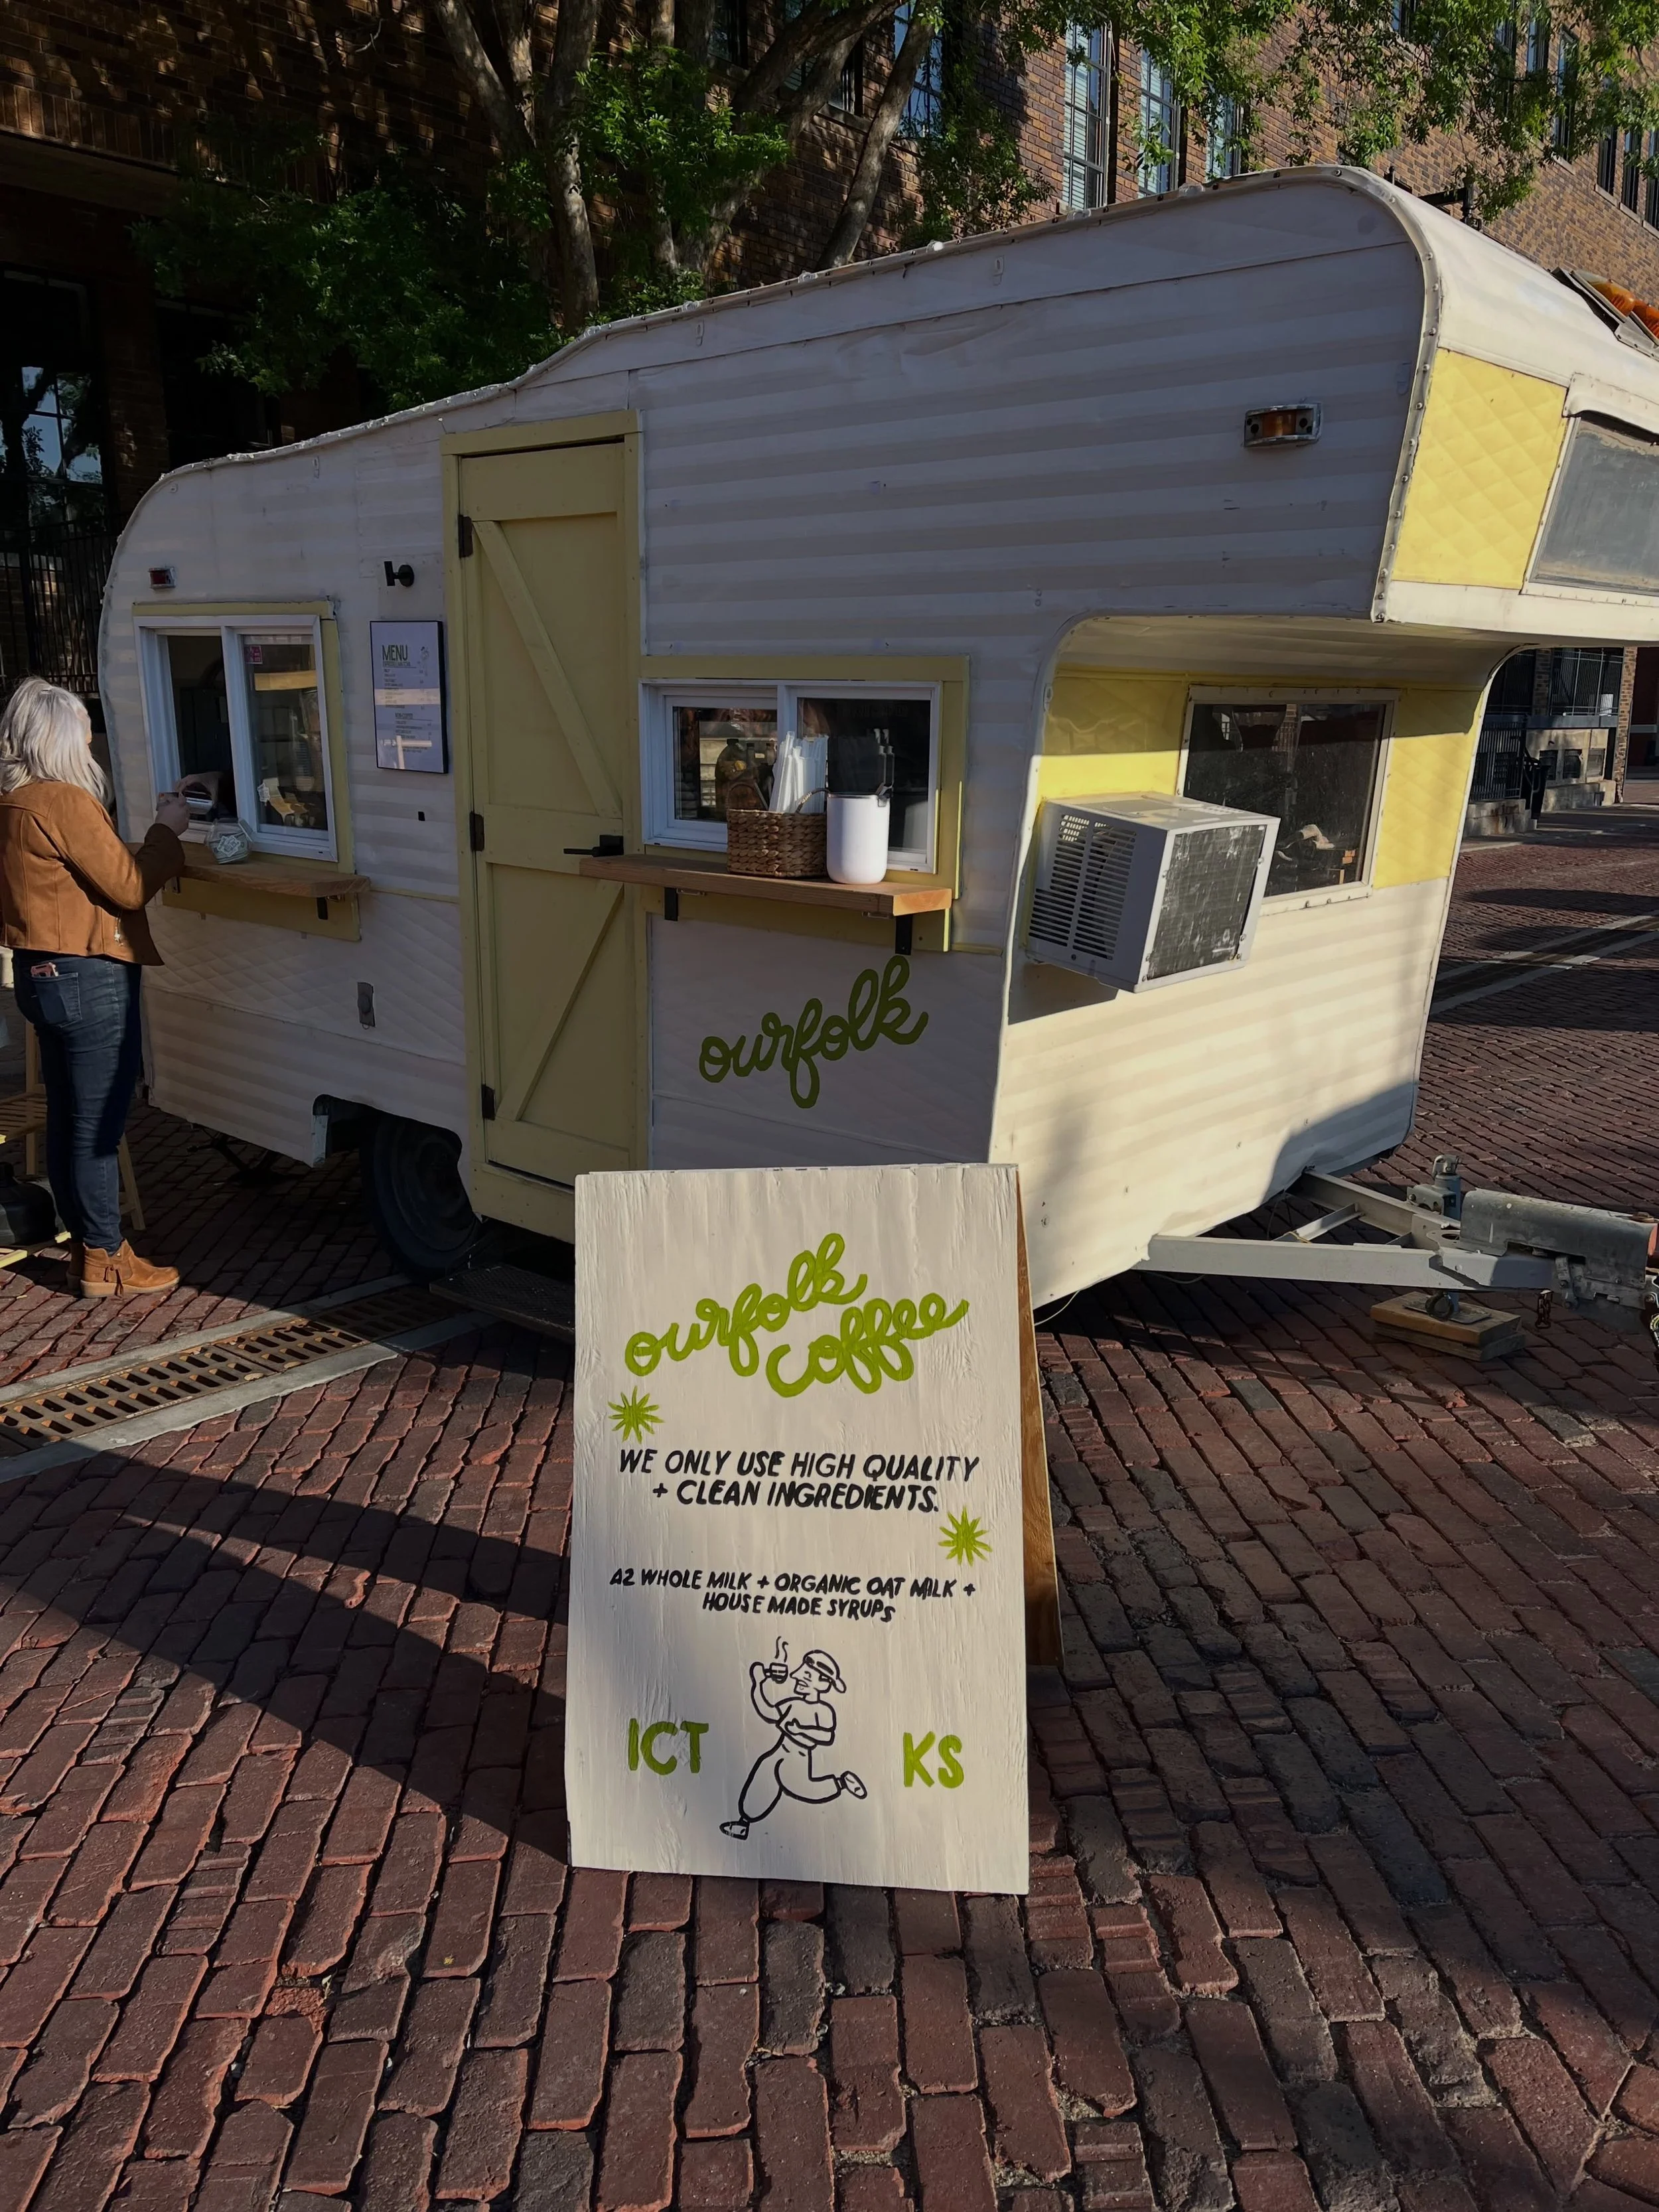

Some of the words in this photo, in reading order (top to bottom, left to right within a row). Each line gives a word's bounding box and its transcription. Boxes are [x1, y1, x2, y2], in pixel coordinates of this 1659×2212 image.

[382, 644, 408, 661] MENU
[699, 954, 929, 1109] ourfolk
[624, 1232, 868, 1378] ourfolk
[620, 1448, 658, 1475] WE
[665, 1449, 732, 1476] ONLY
[737, 1451, 786, 1477] USE
[790, 1451, 856, 1479] HIGH
[863, 1454, 979, 1482] QUALITY
[652, 1483, 668, 1498] +
[676, 1479, 761, 1507] CLEAN
[766, 1481, 938, 1513] INGREDIENTS.
[609, 1568, 636, 1587] A2
[641, 1568, 703, 1590] WHOLE
[706, 1571, 753, 1590] MILK
[757, 1575, 770, 1589] +
[774, 1573, 861, 1595] ORGANIC
[866, 1577, 906, 1599] OAT
[910, 1576, 957, 1600] MILK
[963, 1583, 975, 1596] +
[702, 1591, 765, 1614] HOUSE
[766, 1595, 823, 1616] MADE
[826, 1598, 896, 1623] SYRUPS
[627, 1718, 709, 1776] ICT
[903, 1731, 965, 1789] KS
